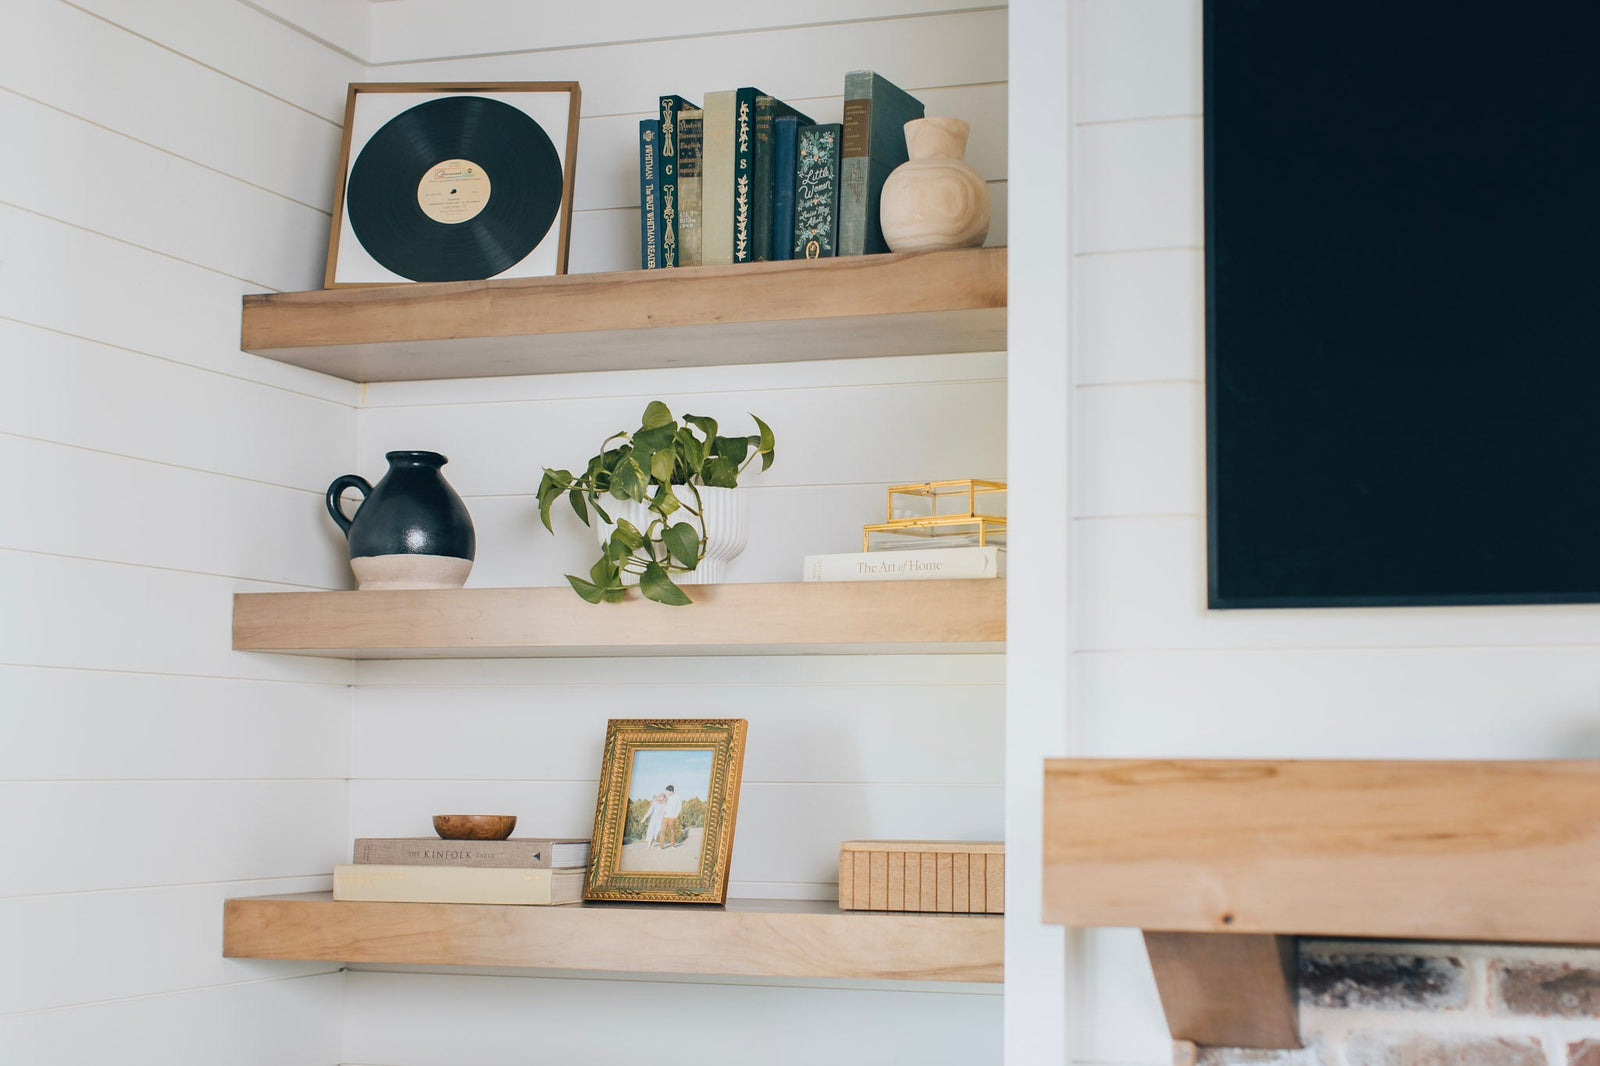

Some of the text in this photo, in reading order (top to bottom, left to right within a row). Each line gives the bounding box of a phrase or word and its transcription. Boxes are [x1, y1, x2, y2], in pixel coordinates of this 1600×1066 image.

[645, 144, 654, 180] WHITMAN
[665, 163, 673, 176] C
[739, 158, 748, 170] S
[802, 166, 829, 185] Little
[798, 181, 833, 199] Women
[646, 194, 655, 211] WALT
[646, 211, 656, 244] WHITMAN
[647, 244, 656, 270] READER
[856, 559, 942, 575] The Art of Home
[424, 850, 472, 860] KINFOLK
